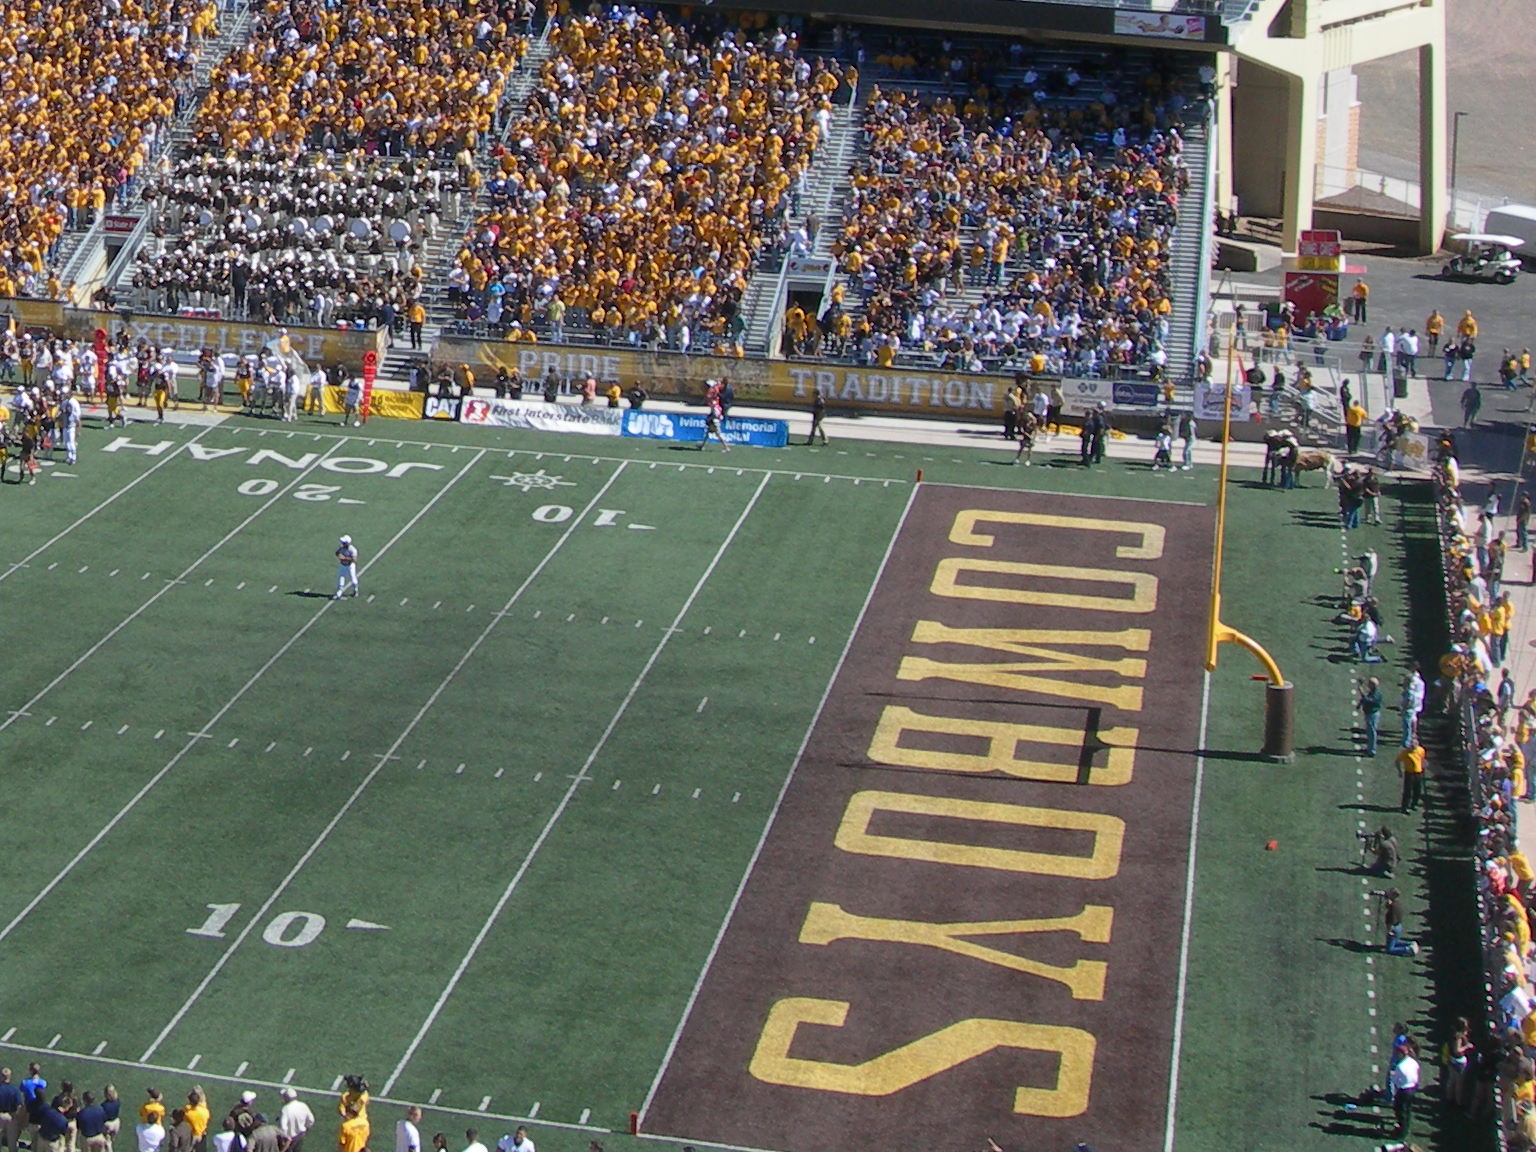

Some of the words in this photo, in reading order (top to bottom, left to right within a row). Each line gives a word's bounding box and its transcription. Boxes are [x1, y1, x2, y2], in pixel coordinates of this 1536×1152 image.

[518, 349, 621, 383] PRIDE
[788, 367, 996, 411] TRADITION
[426, 396, 460, 419] CAT
[524, 404, 590, 425] Interstate
[725, 419, 778, 433] Memorial
[100, 436, 444, 479] JONAH
[237, 478, 343, 502] 20
[531, 503, 627, 528] 10
[749, 509, 1166, 1117] COWBOYS
[185, 902, 327, 947] 10
